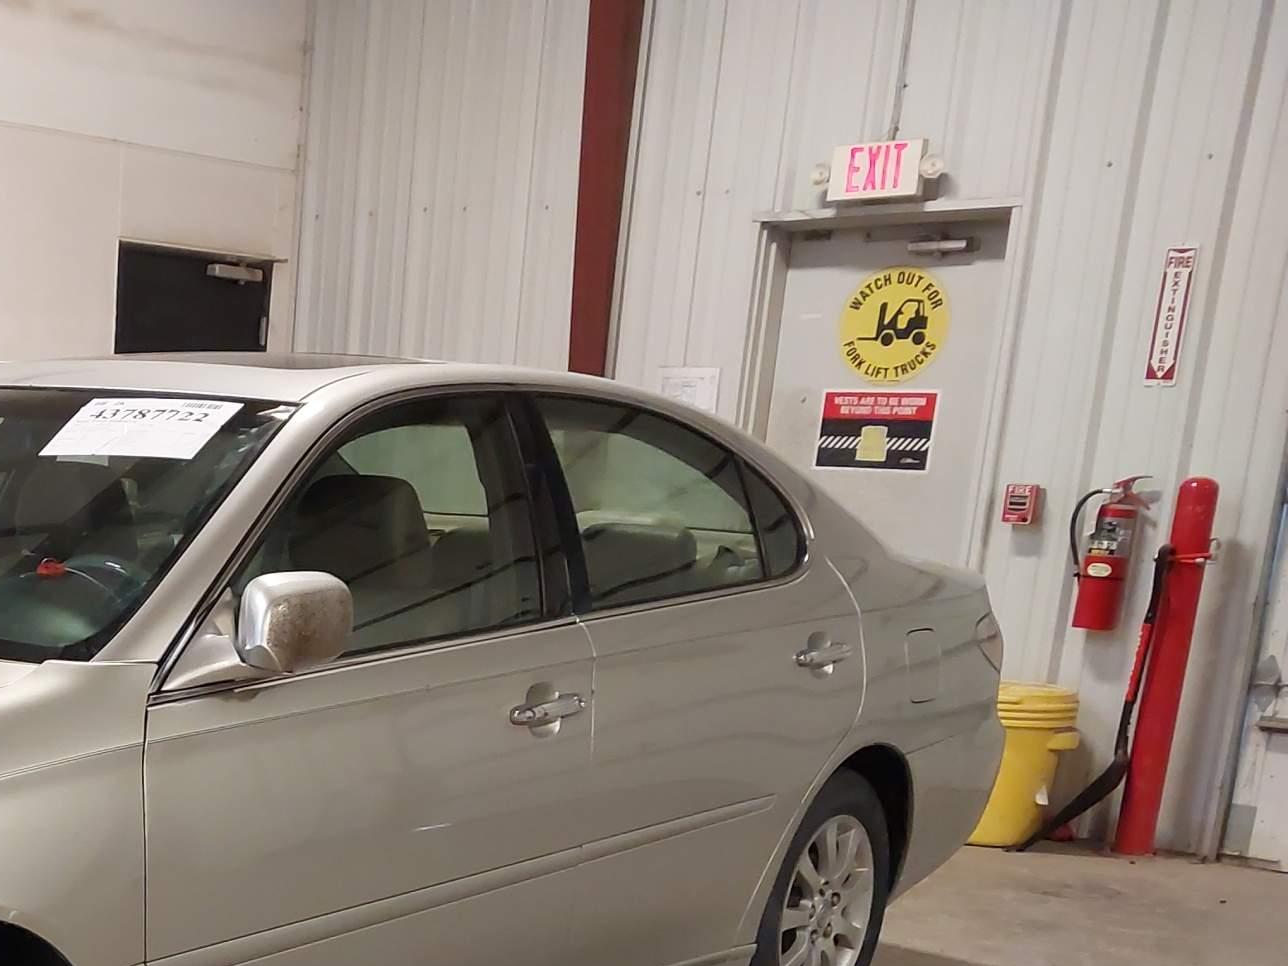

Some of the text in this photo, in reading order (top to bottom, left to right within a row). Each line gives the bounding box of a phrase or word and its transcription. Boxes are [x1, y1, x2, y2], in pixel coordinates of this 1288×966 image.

[845, 143, 909, 193] EXIT
[1167, 256, 1193, 269] FIRE
[849, 271, 943, 311] WATCH OUT FOR
[1156, 271, 1182, 372] EXTINGUISHER
[843, 340, 937, 379] FORK LIFT TRUCKS
[90, 408, 210, 423] 43787722
[1008, 485, 1032, 495] FIRE
